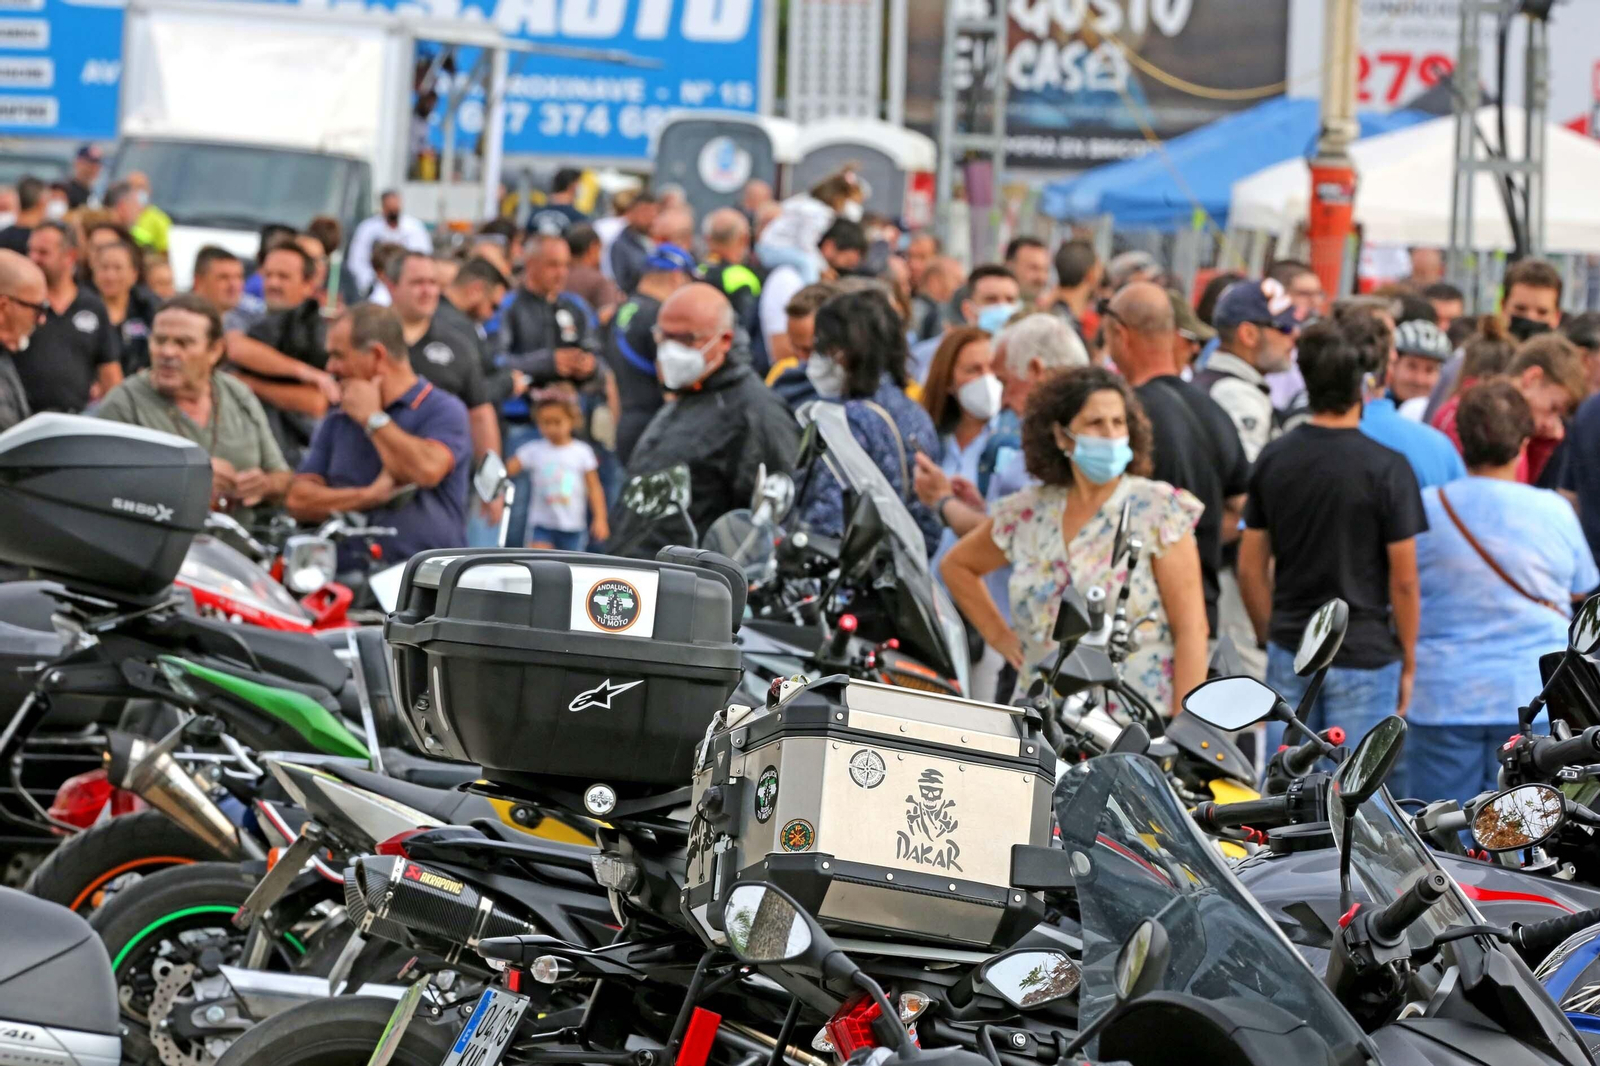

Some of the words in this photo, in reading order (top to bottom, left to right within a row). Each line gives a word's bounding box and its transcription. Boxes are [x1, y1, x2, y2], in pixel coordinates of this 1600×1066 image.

[538, 102, 610, 138] 374
[596, 614, 606, 625] TU
[606, 618, 629, 627] MOTO
[603, 613, 622, 621] DESDE
[896, 830, 964, 873] DAKAR
